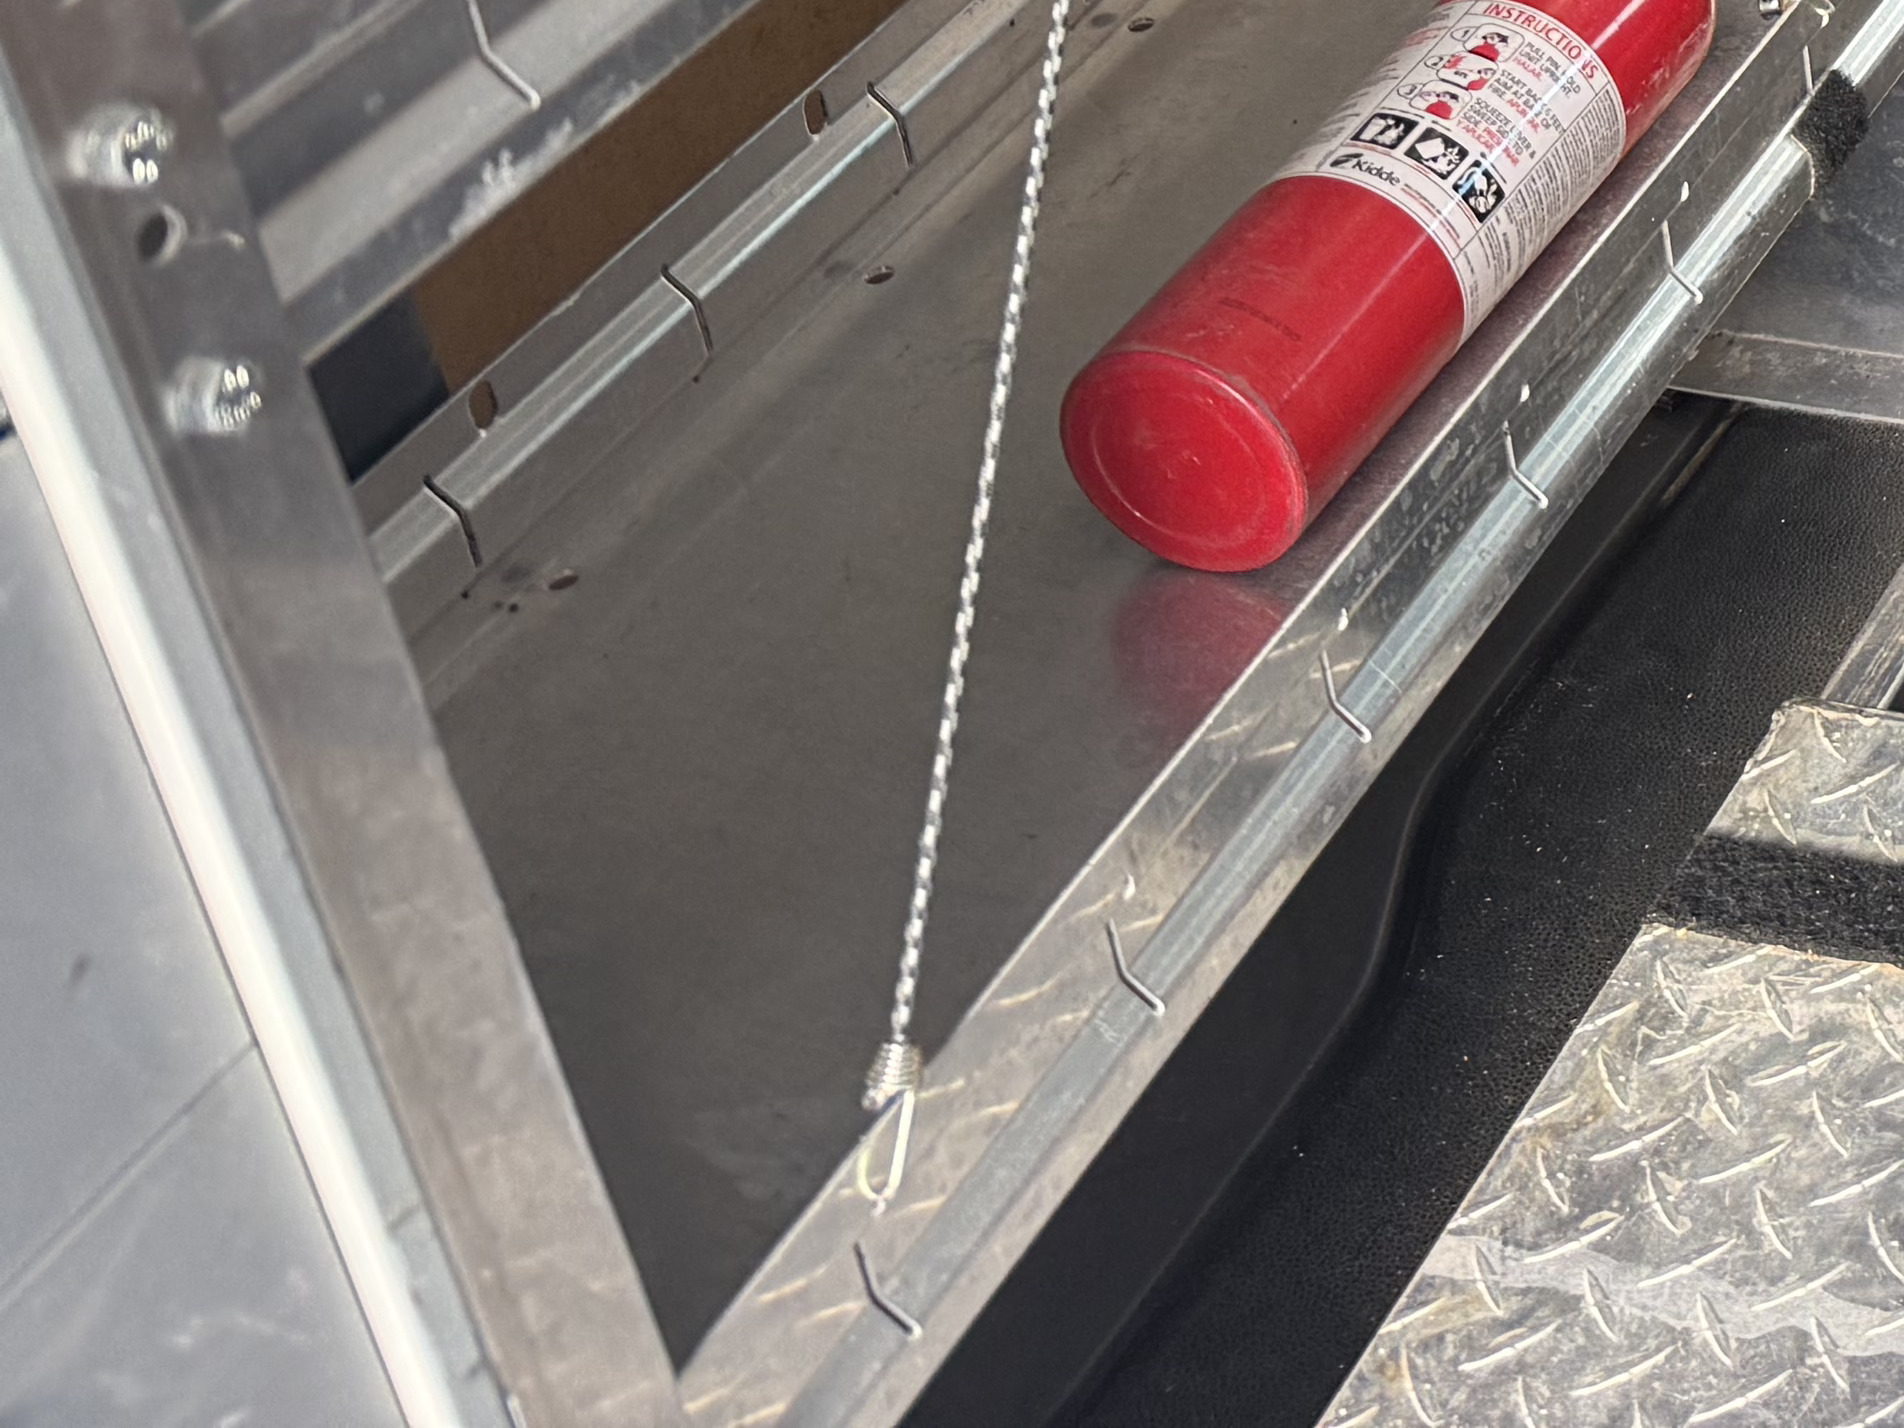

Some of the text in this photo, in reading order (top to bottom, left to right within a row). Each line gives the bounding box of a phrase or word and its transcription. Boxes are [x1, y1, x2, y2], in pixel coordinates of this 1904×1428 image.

[1482, 2, 1599, 80] INSTRUCTIONS
[1506, 98, 1541, 134] APUNAR.
[1522, 98, 1543, 118] BAE
[1352, 158, 1401, 187] Kidde
